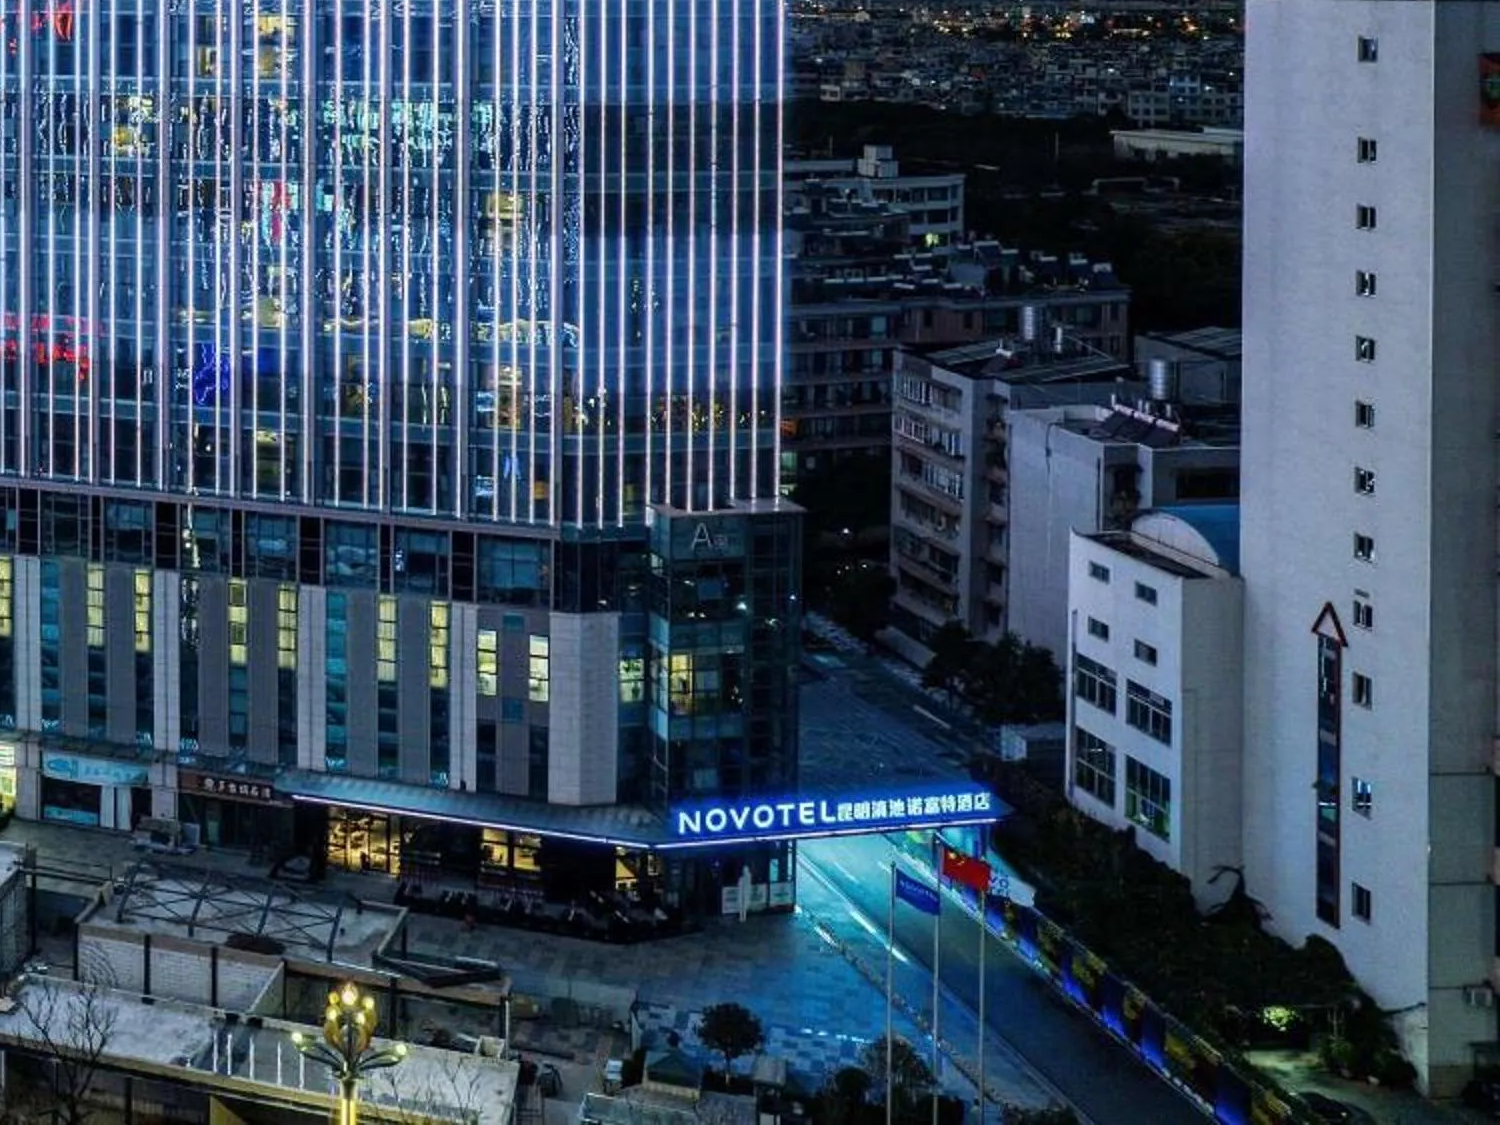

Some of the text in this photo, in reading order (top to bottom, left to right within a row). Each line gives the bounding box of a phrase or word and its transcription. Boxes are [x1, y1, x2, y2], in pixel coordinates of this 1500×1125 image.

[679, 792, 991, 834] NOVOTEL 昆明滇池诺富特酒店
